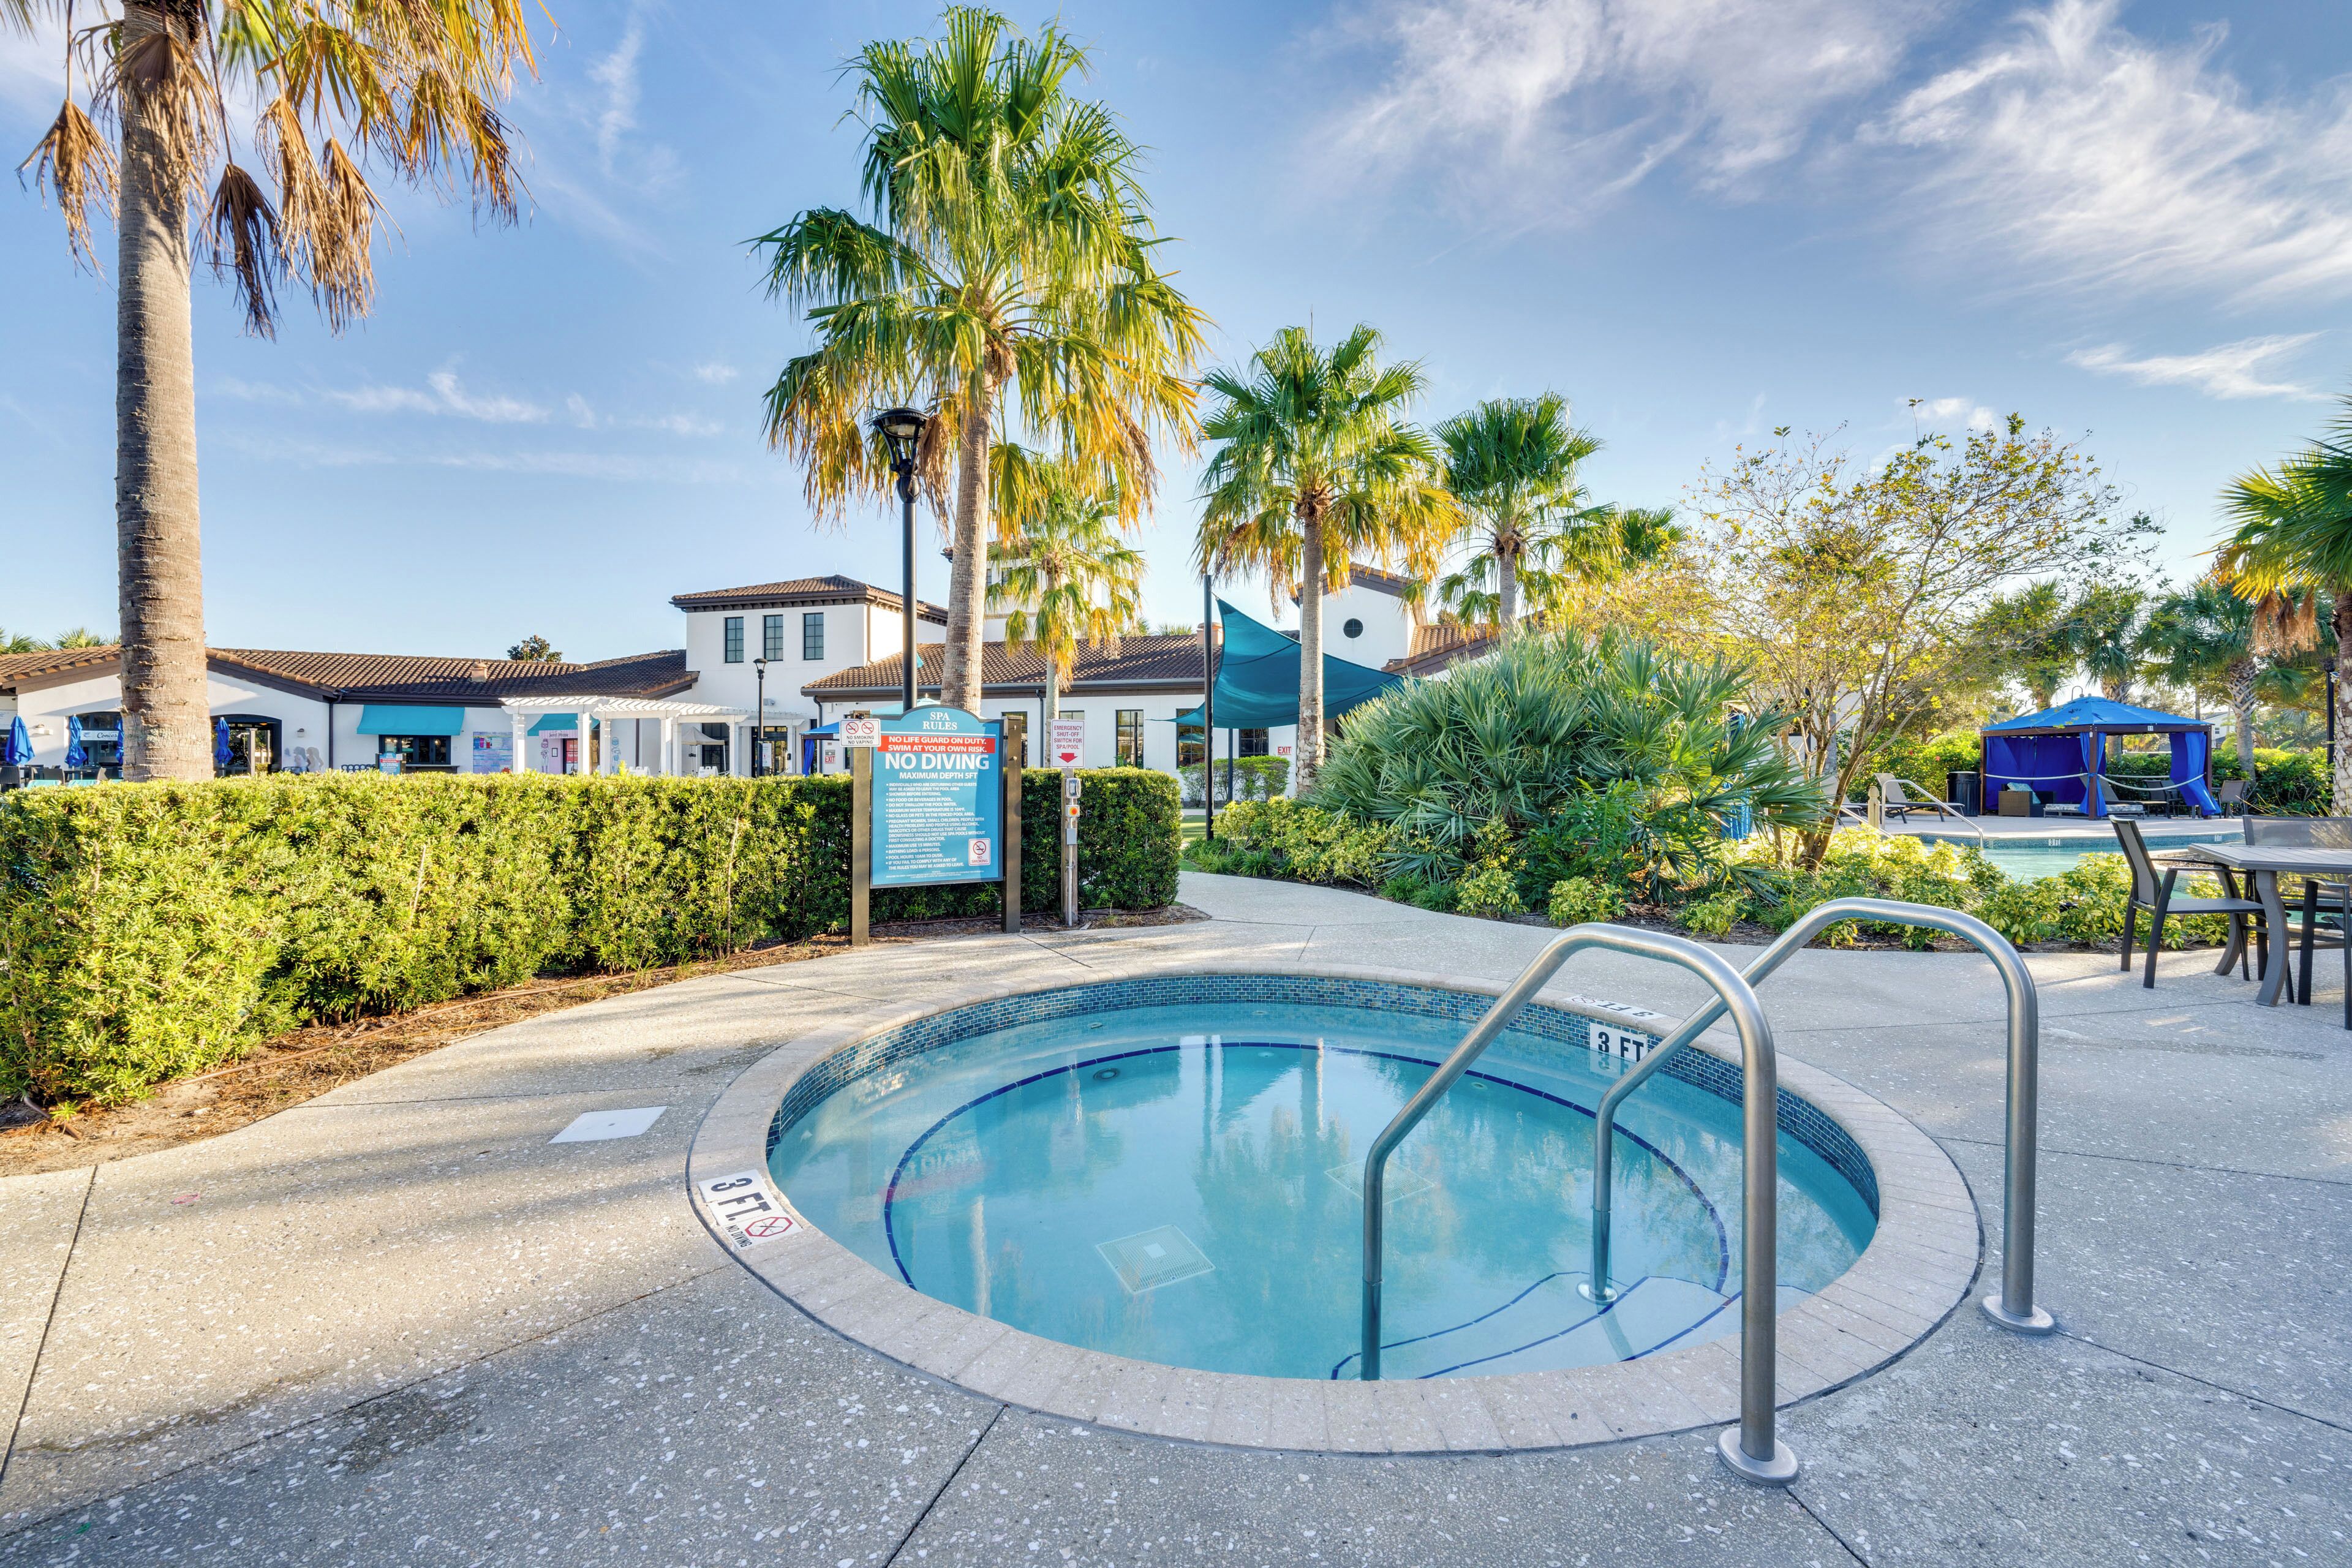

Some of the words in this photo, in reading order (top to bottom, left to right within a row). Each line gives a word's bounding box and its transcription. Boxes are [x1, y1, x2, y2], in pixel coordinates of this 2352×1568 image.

[930, 712, 949, 720] SPA
[922, 722, 957, 730] RULES
[885, 753, 917, 769] NO
[921, 753, 990, 770] DIVING
[1598, 1031, 1610, 1053] 3
[1620, 1036, 1644, 1062] FT
[711, 1178, 753, 1192] 3
[718, 1192, 772, 1221] FT.
[726, 1225, 740, 1234] NO
[733, 1230, 752, 1248] DIVING
